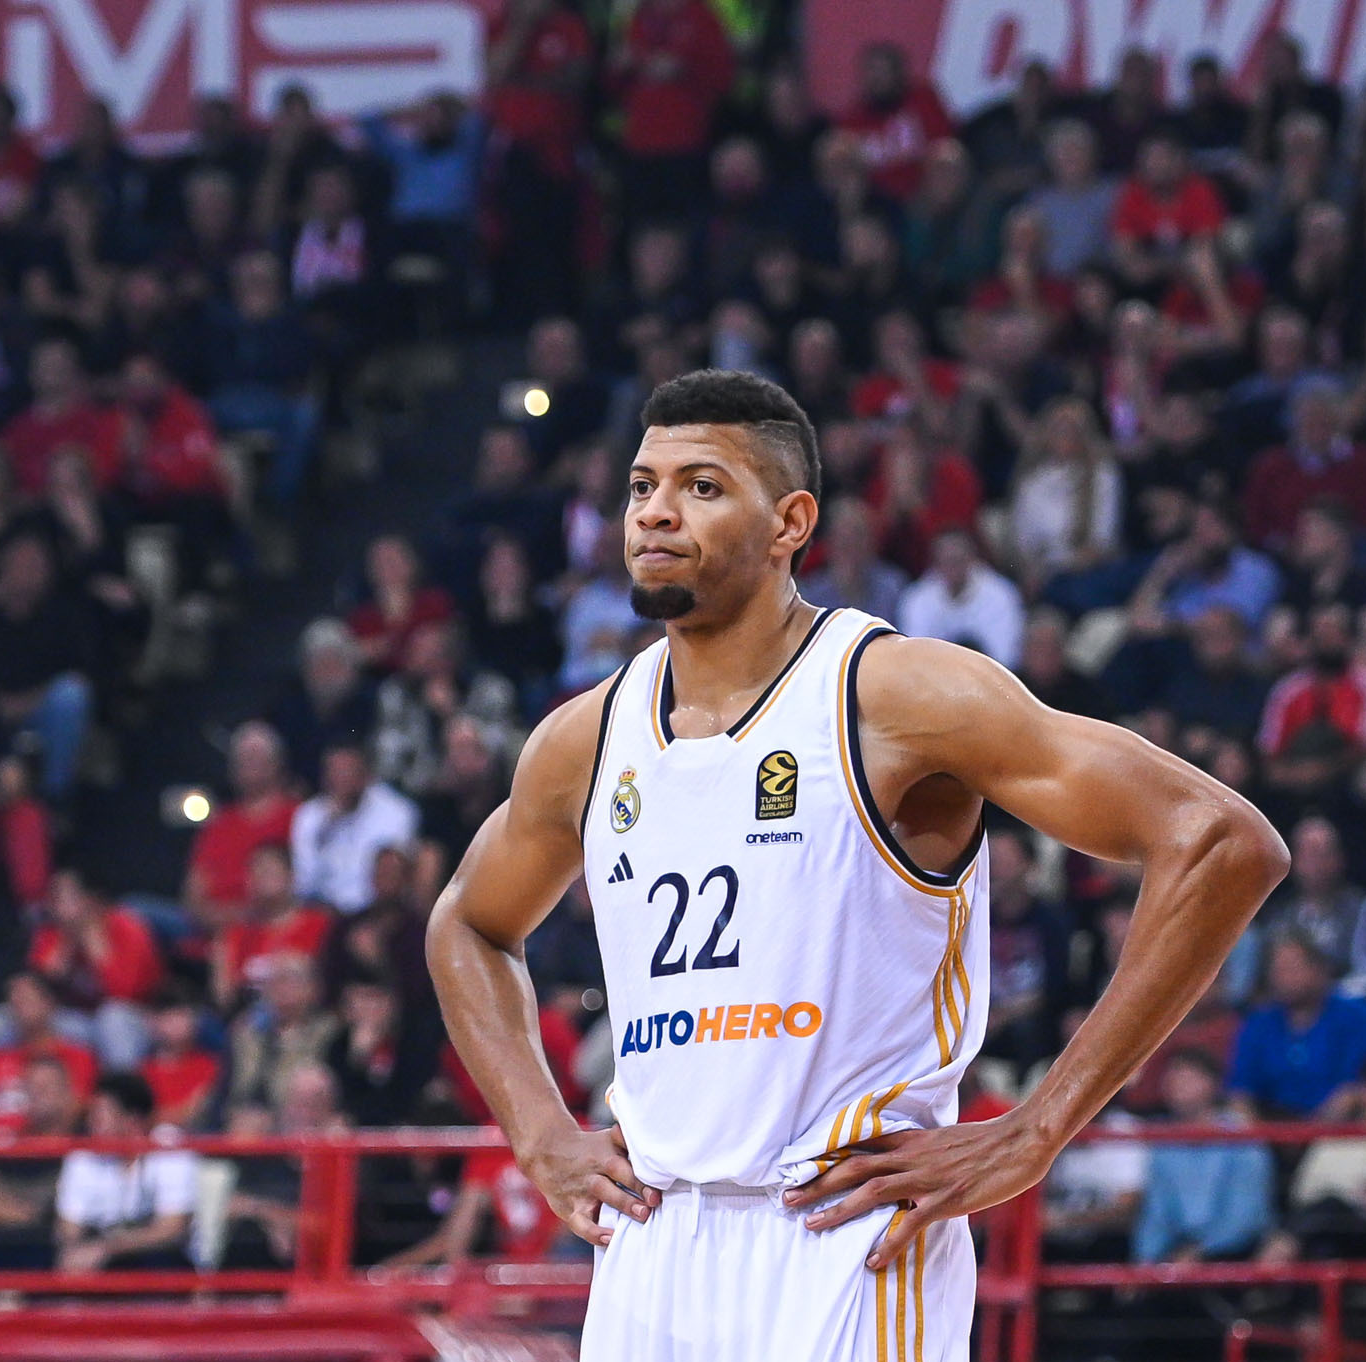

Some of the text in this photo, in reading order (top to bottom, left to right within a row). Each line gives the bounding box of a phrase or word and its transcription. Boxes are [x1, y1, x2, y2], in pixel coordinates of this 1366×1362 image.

[760, 794, 794, 804] TURKISH
[760, 802, 793, 811] AIRLINES
[745, 831, 803, 844] oneteam
[647, 864, 740, 979] 22
[620, 1001, 823, 1058] AUTOHERO
